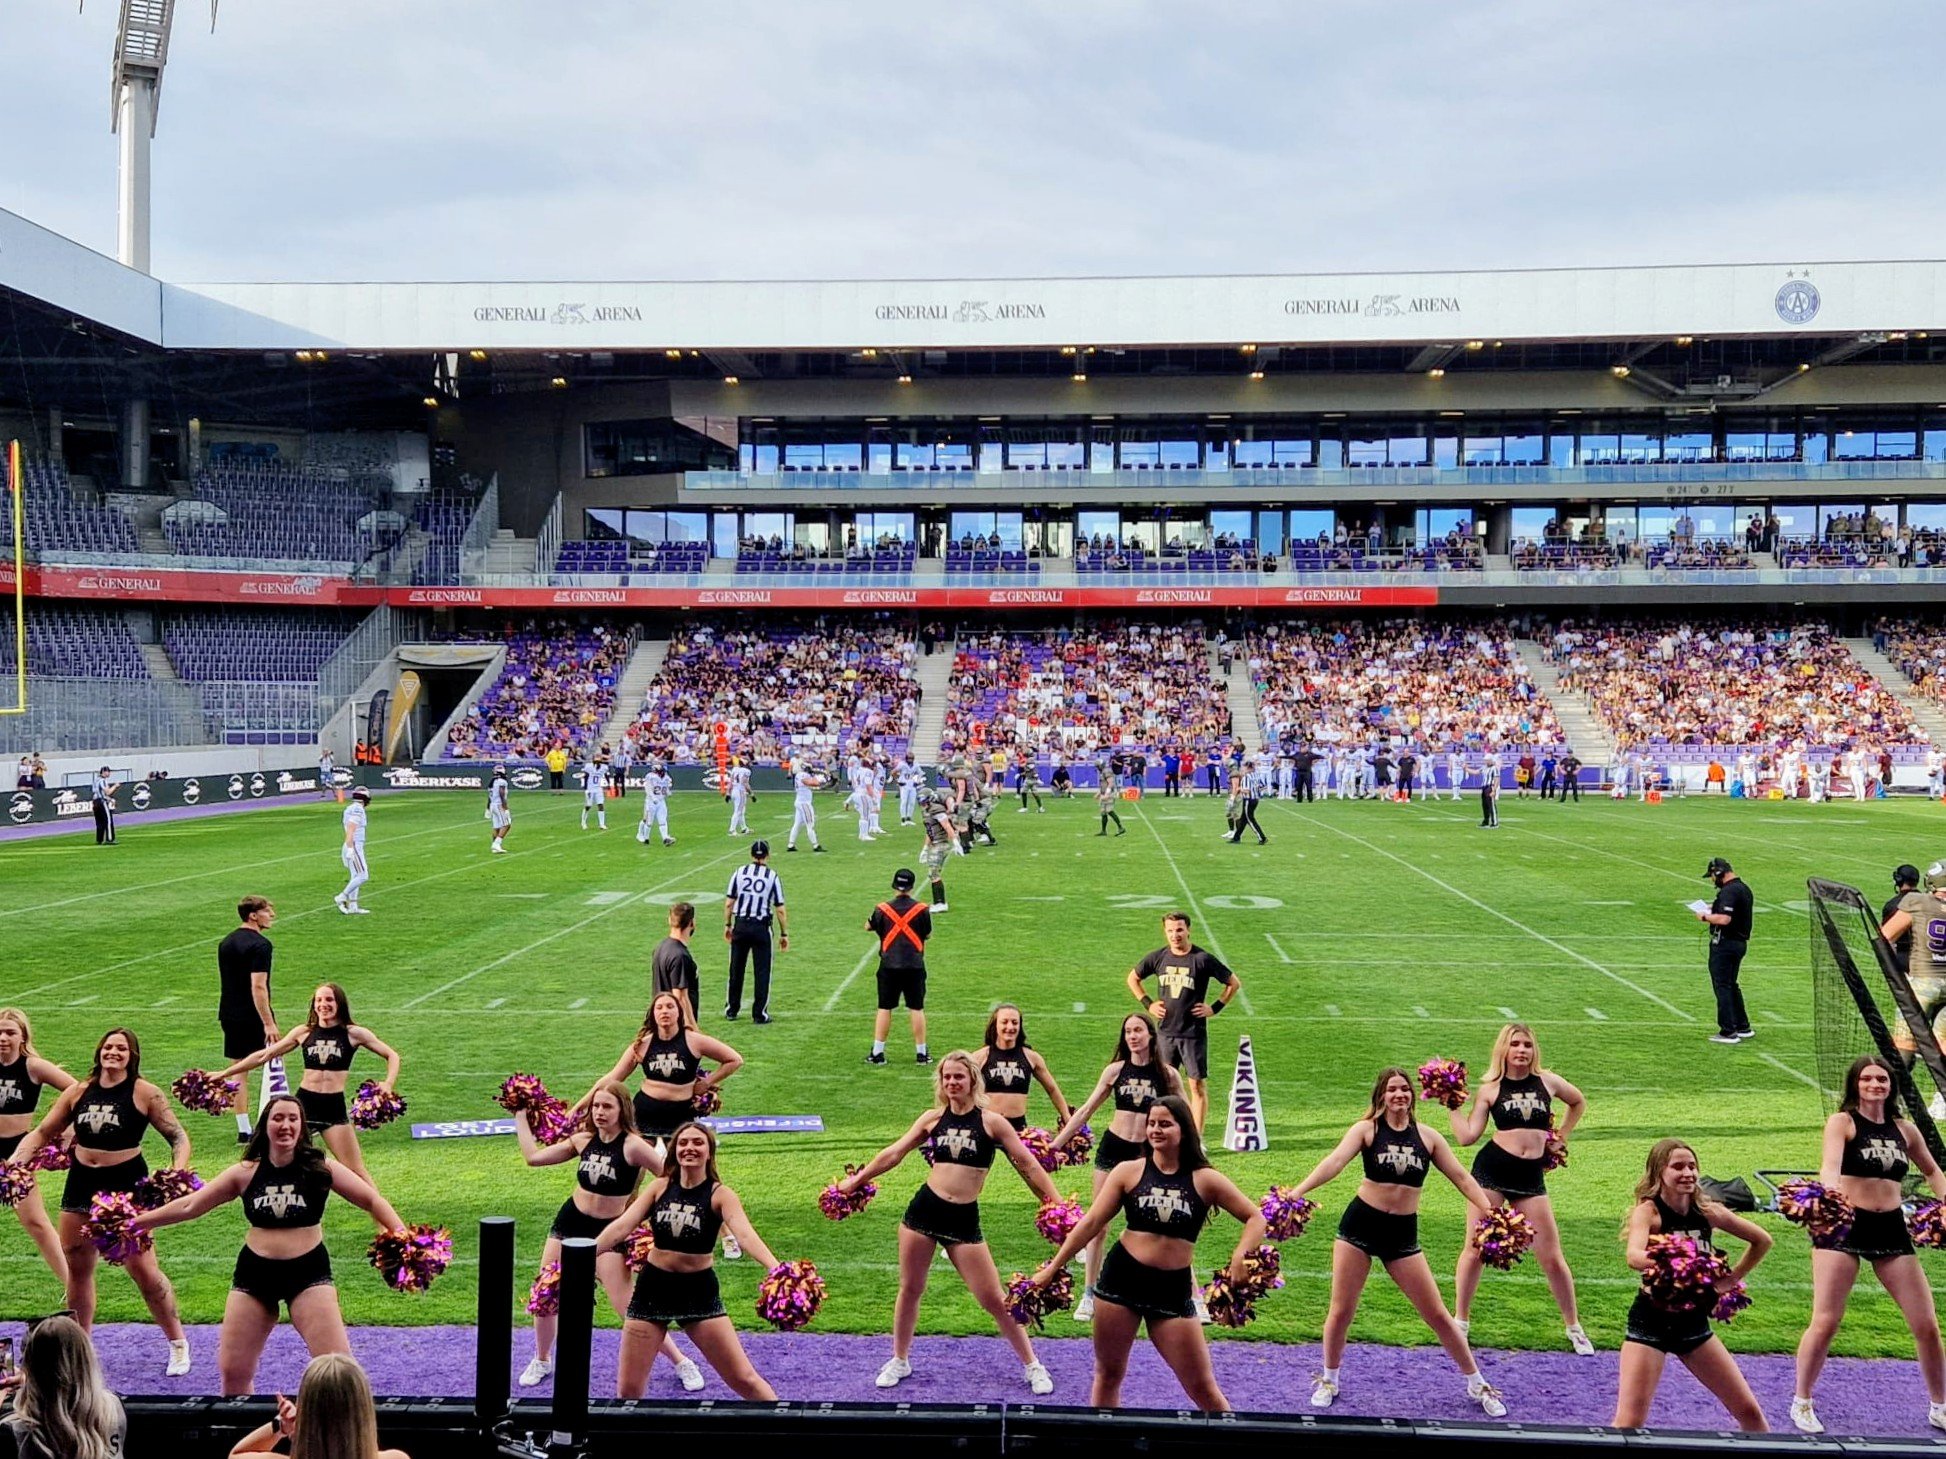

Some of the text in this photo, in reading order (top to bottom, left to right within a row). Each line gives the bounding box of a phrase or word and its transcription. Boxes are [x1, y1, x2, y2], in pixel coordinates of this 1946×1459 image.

[473, 305, 643, 322] GENERALI ARENA
[875, 303, 1047, 320] GENERALI ARENA
[1284, 297, 1461, 315] GENERALI ARENA
[99, 576, 161, 591] GENERALI
[426, 590, 482, 602] GENERALI
[570, 590, 626, 602] GENERALI
[715, 590, 771, 602] GENERALI
[860, 590, 917, 602] GENERALI
[1006, 590, 1064, 602] GENERALI
[1154, 589, 1212, 601] GENERALI
[1303, 589, 1362, 602] GENERALI
[390, 776, 482, 788] LEBERKÄSE
[742, 877, 766, 894] 20
[1158, 974, 1195, 990] VIENNA
[649, 1060, 686, 1071] VIENNA
[989, 1067, 1026, 1079] VIENNA
[1233, 1040, 1260, 1151] VIKINGS
[1503, 1098, 1547, 1112] VIENNA
[77, 1111, 120, 1126] VIENNA
[420, 1125, 517, 1138] LOUD
[936, 1135, 977, 1152] VIENNA
[1377, 1152, 1423, 1171] VIENNA
[1860, 1146, 1909, 1165] VIENNA
[578, 1160, 617, 1180] VIENNA
[253, 1193, 307, 1210] VIENNA
[1138, 1195, 1192, 1217] VIENNA
[656, 1210, 701, 1230] VIENNA
